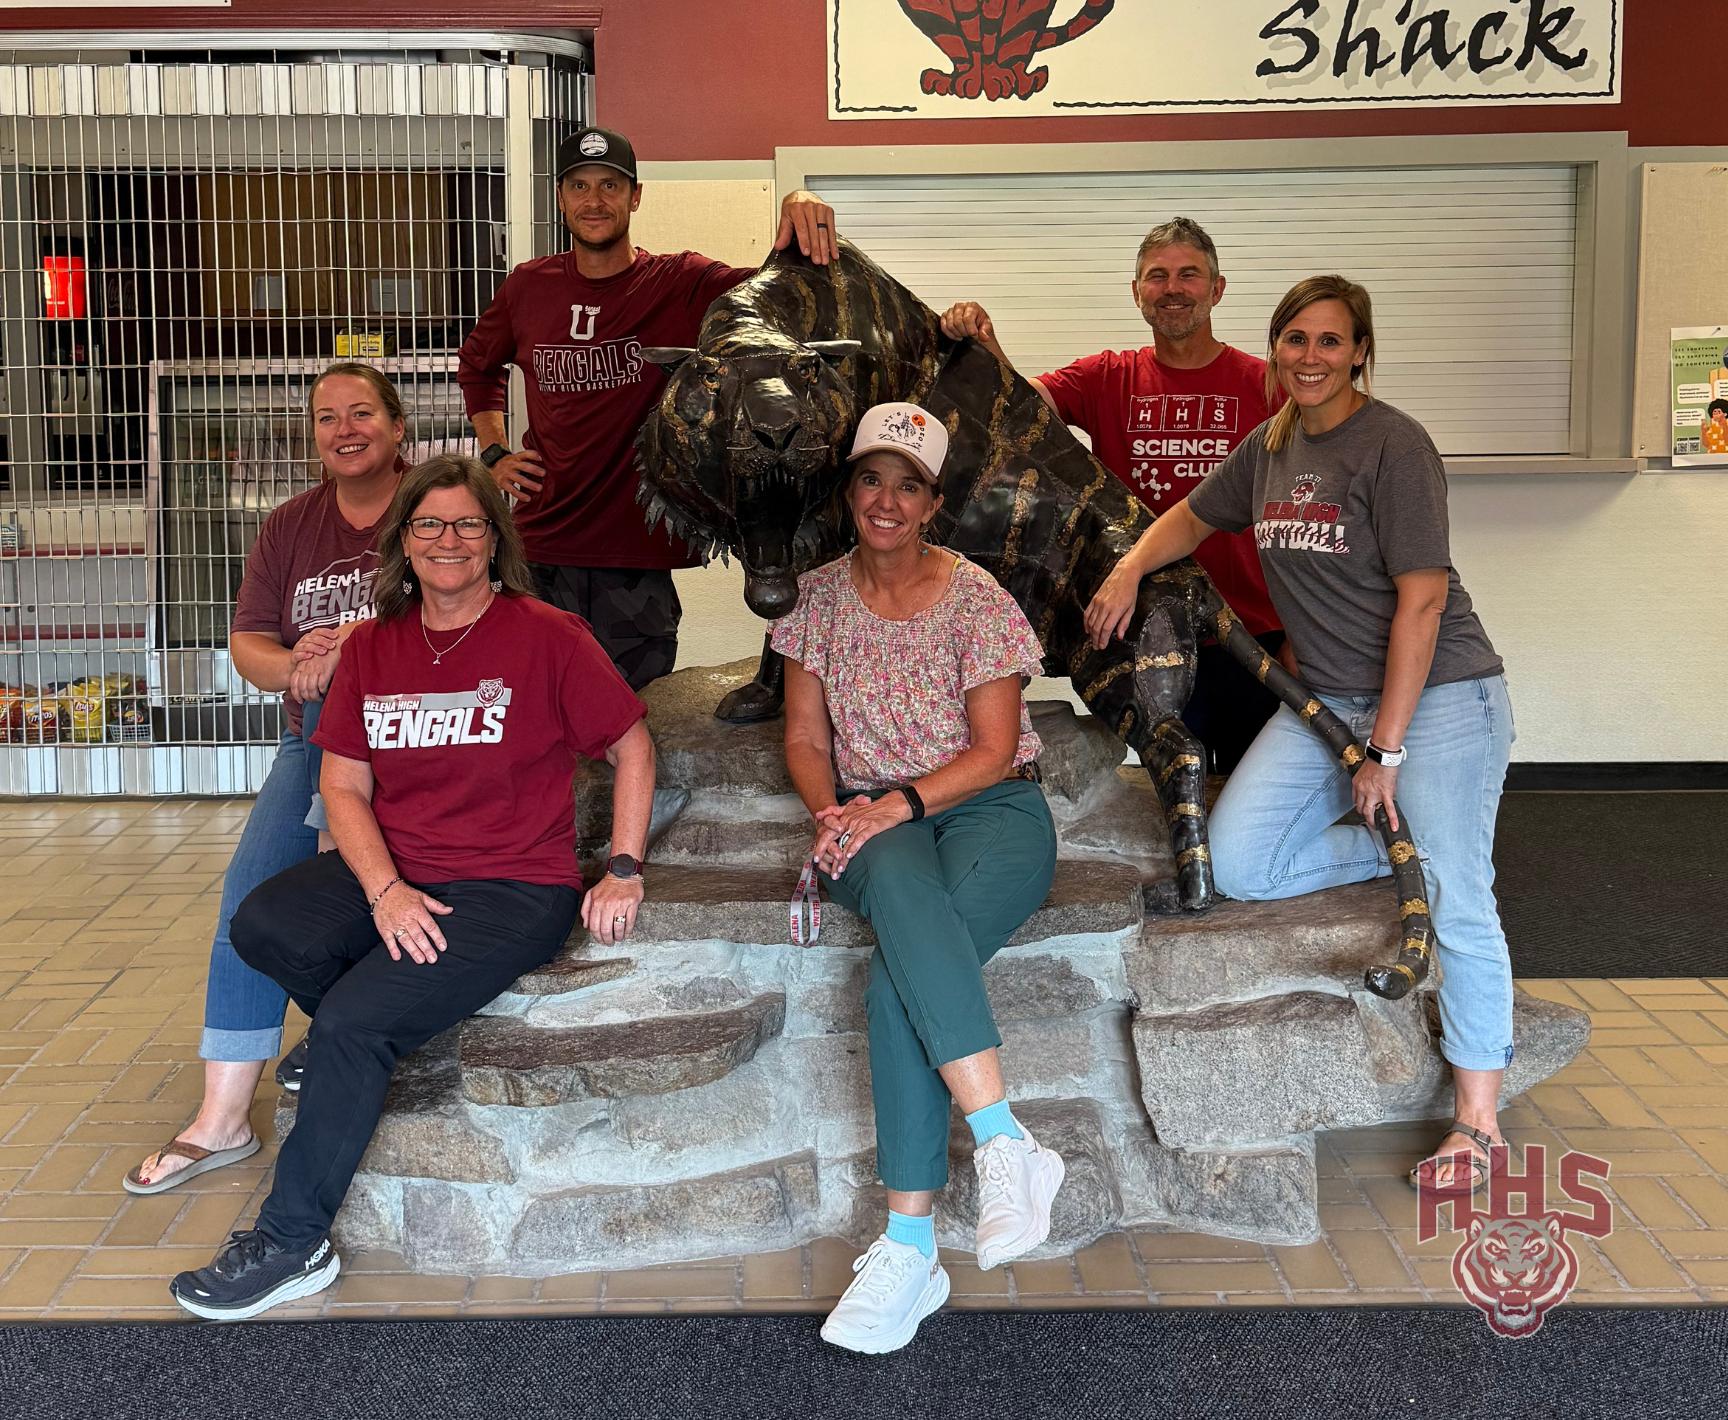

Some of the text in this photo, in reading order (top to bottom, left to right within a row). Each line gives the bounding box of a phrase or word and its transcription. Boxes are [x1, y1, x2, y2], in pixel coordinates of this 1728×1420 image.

[533, 341, 644, 384] BENGALS
[1138, 408, 1225, 422] H H S
[1131, 439, 1230, 456] SCIENCE
[1300, 501, 1341, 524] HIGH
[294, 568, 360, 597] HELENA
[292, 580, 376, 625] BENG
[340, 602, 377, 626] BA
[75, 701, 94, 713] Lays
[363, 700, 420, 713] HELENA HIGH
[363, 705, 506, 750] BENGALS
[304, 1238, 331, 1271] HOKA
